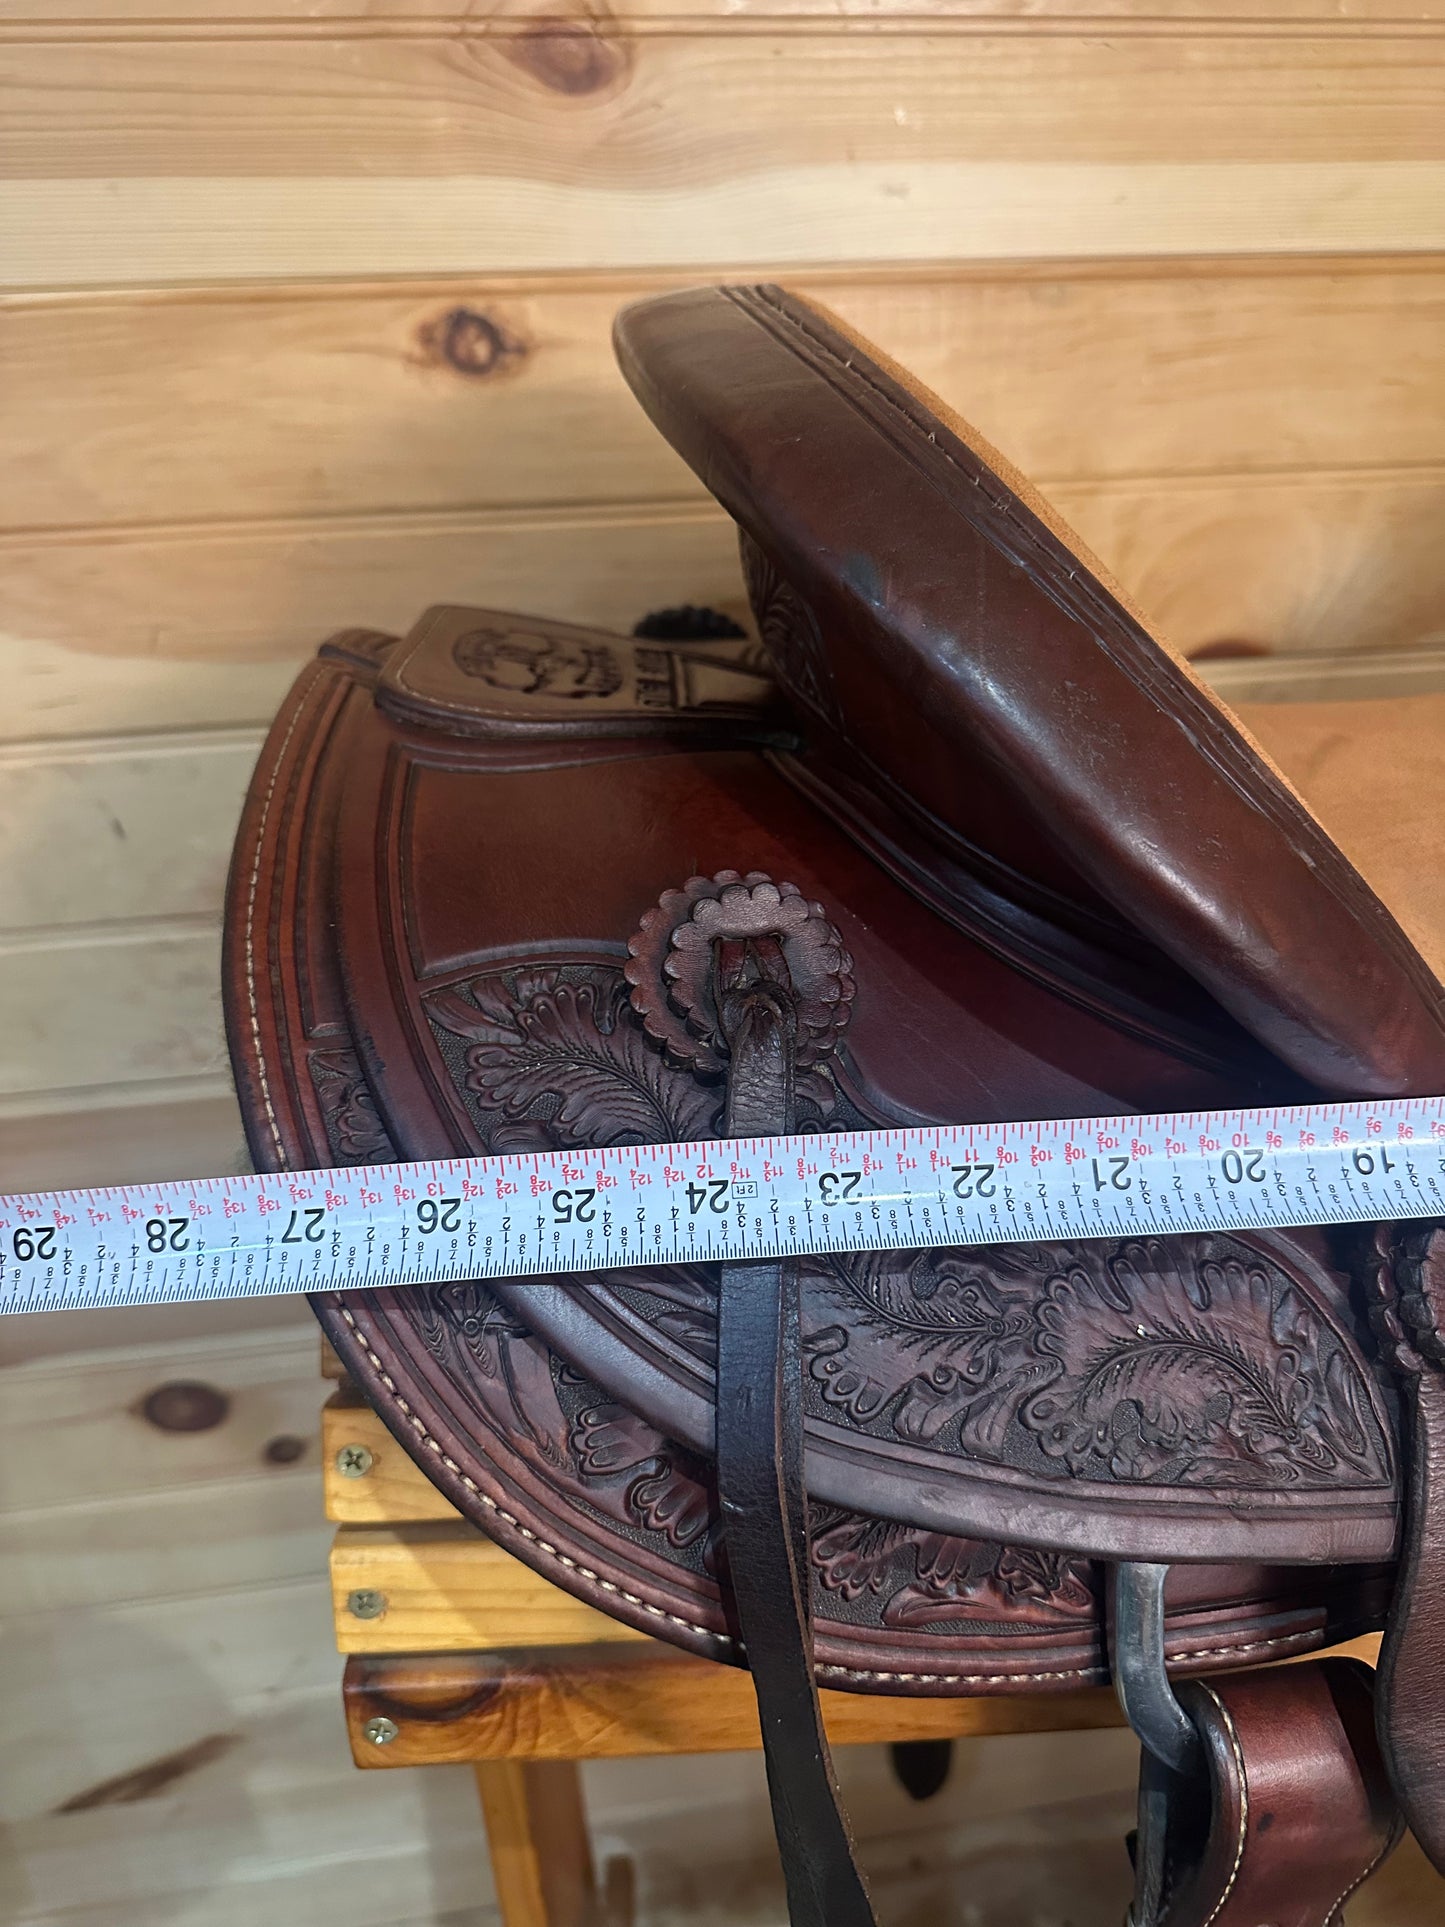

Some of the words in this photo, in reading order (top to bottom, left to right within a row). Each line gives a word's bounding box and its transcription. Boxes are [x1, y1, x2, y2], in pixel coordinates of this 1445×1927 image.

[964, 1149, 981, 1162] 11
[1233, 1134, 1250, 1147] 10
[697, 1165, 714, 1178] 12
[1091, 1157, 1132, 1192] 21
[1222, 1148, 1266, 1184] 20
[1352, 1141, 1395, 1176] 19
[427, 1183, 444, 1197] 13
[685, 1179, 729, 1215] 24
[736, 1185, 745, 1193] Ft
[747, 1185, 753, 1193] 2
[818, 1171, 862, 1207] 23
[952, 1164, 996, 1200] 22
[156, 1202, 173, 1215] 14
[417, 1198, 461, 1234] 26
[552, 1188, 596, 1224] 25
[146, 1217, 190, 1253] 28
[281, 1208, 325, 1244] 27
[13, 1227, 57, 1261] 29
